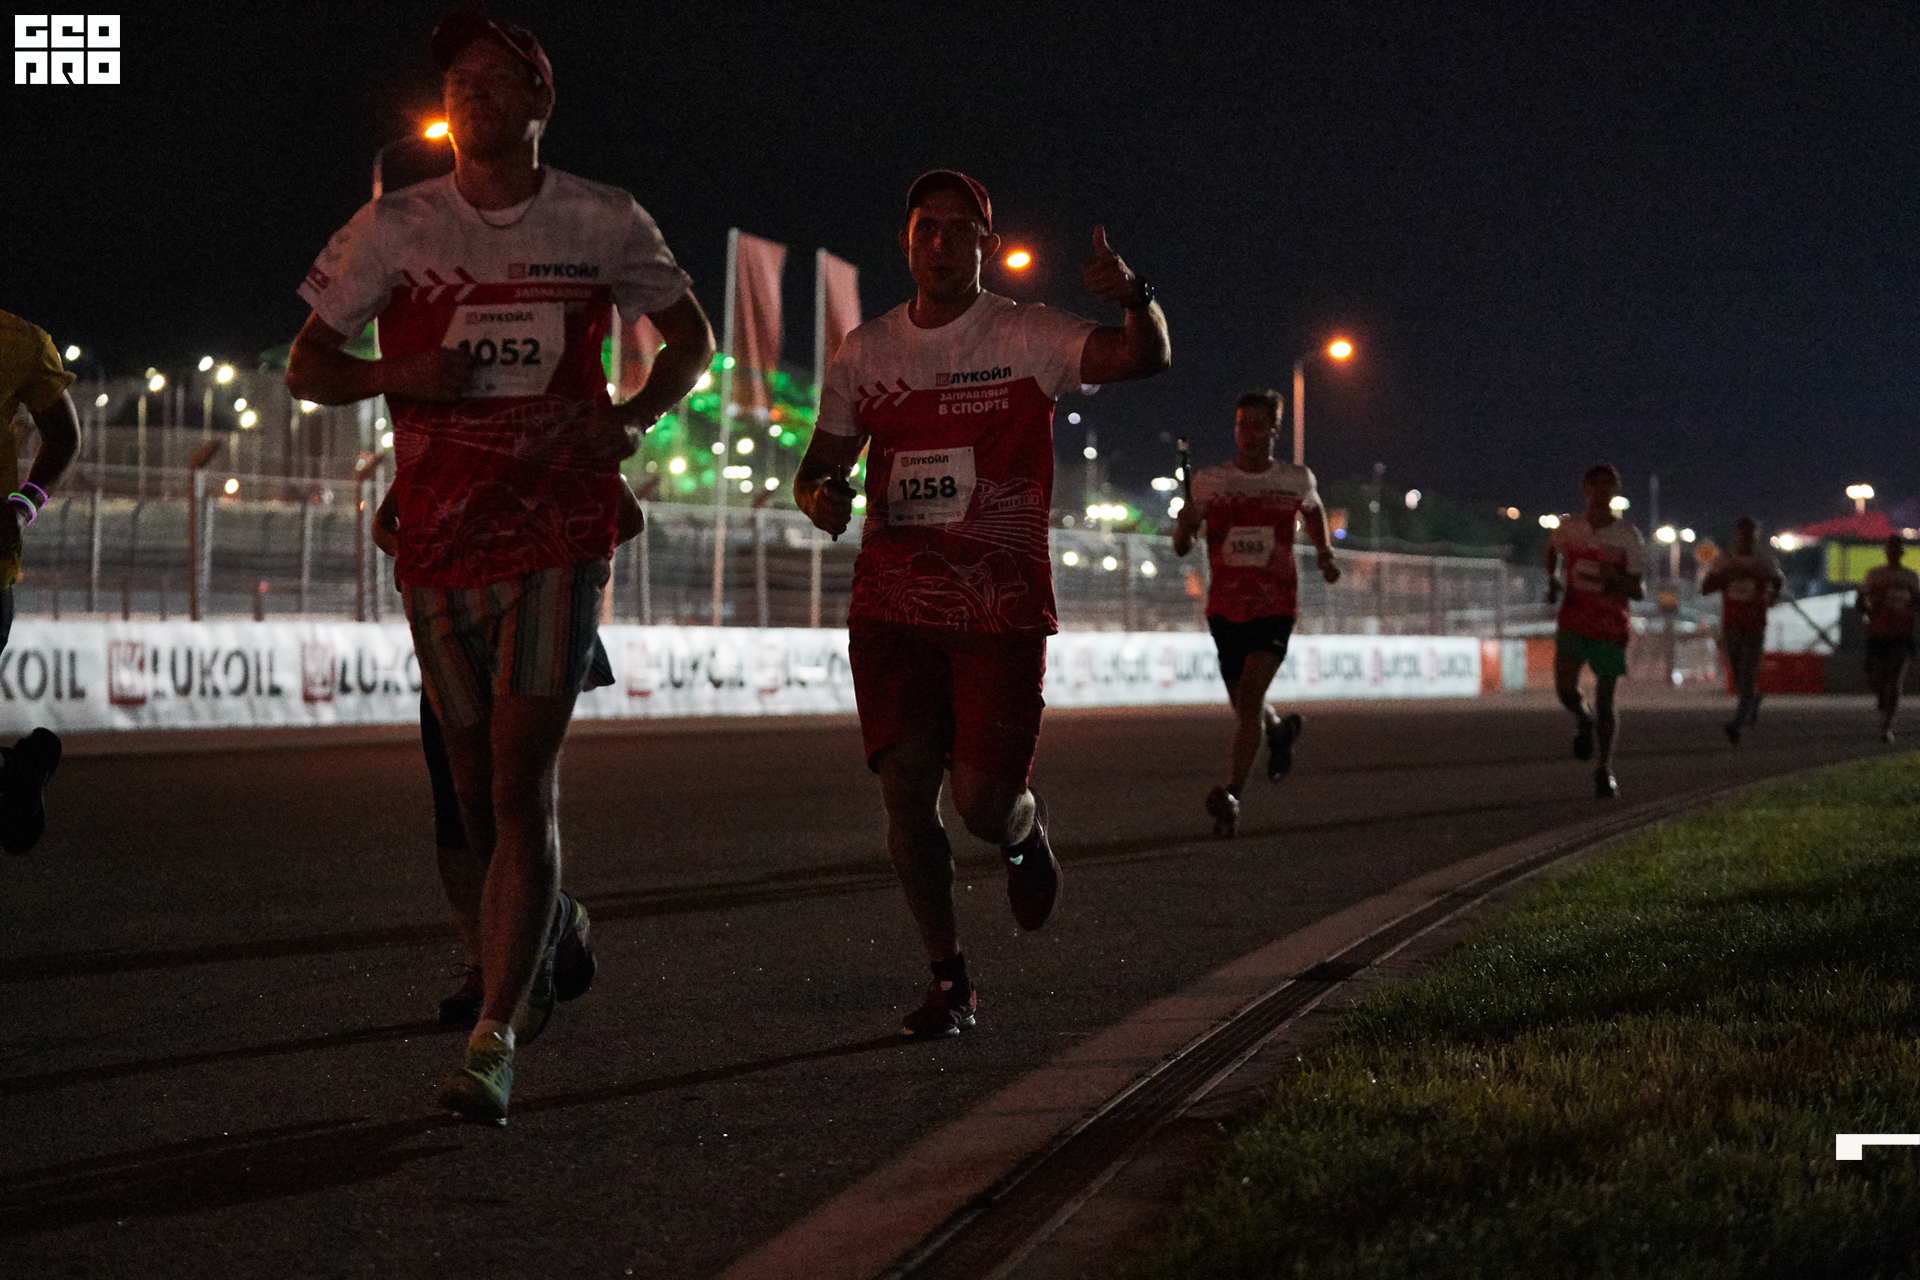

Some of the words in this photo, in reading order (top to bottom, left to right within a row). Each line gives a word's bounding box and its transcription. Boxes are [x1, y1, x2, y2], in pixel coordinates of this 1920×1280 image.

[528, 262, 600, 278] ЛУКОЙЛ
[479, 312, 534, 323] ЛУКОЙЛ
[950, 366, 1012, 384] ЛУКОЙЛ
[940, 387, 1009, 401] ЗАПРАВЛЯЕМ
[938, 403, 949, 415] В
[951, 398, 1010, 415] СПОРТЕ
[909, 454, 949, 466] ЛУКОЙЛ
[899, 476, 957, 500] 1258
